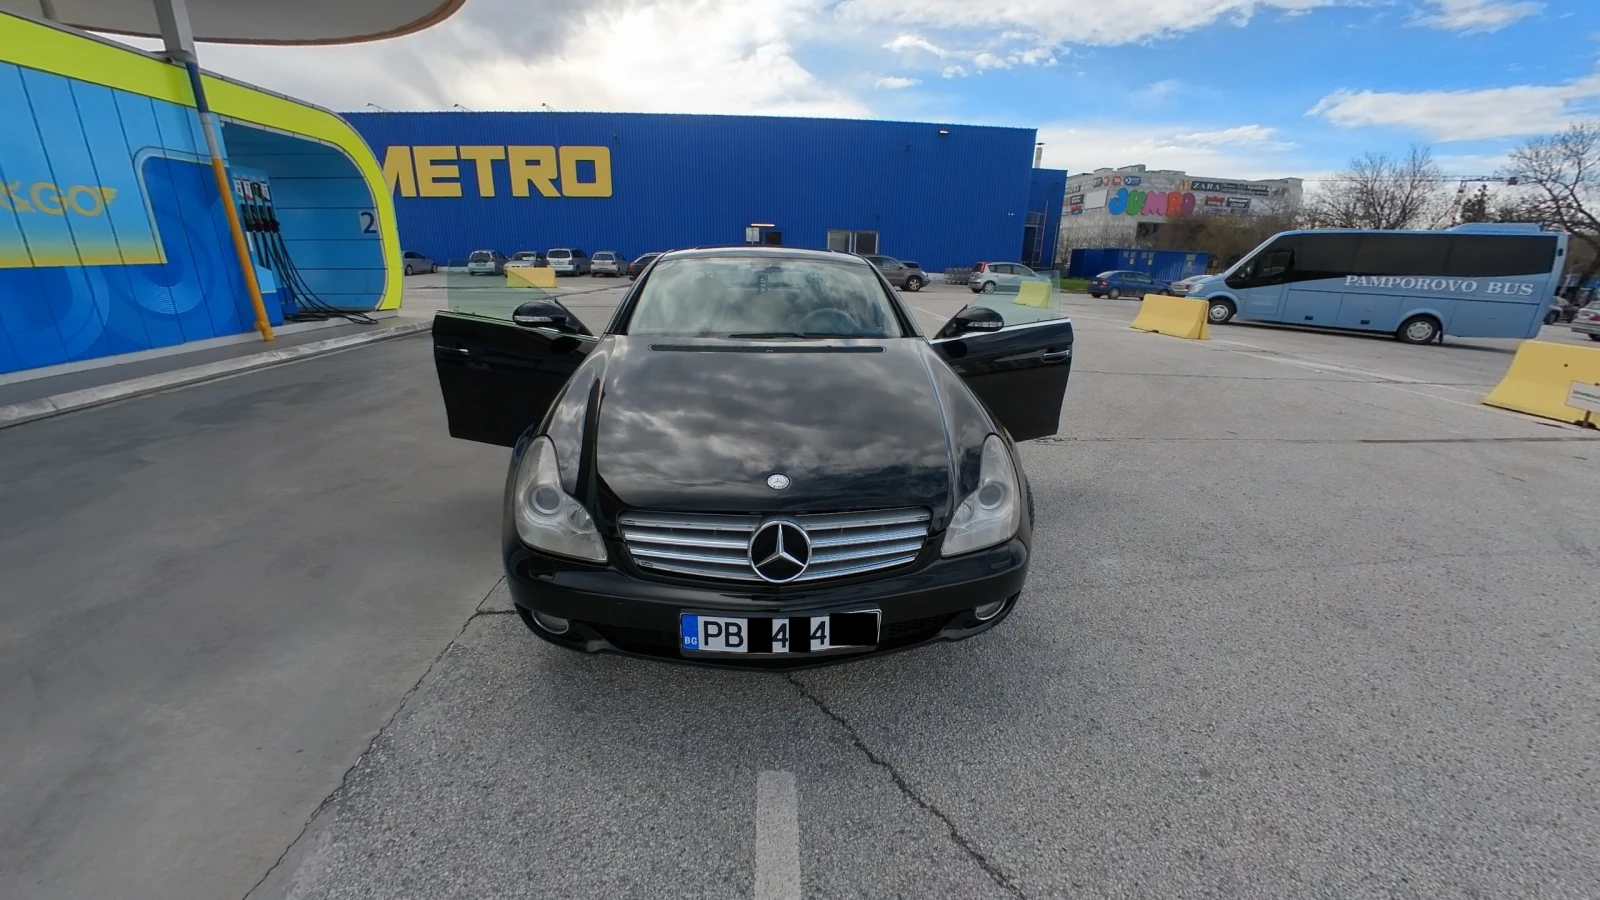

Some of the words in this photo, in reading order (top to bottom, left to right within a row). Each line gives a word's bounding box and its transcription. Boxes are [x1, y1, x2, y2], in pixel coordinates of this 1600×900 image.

[383, 145, 613, 197] METRO
[1193, 182, 1220, 191] ZARA
[1109, 187, 1196, 216] JUMBO
[360, 211, 378, 234] 2
[1344, 275, 1478, 292] PAMPOROVO
[1486, 281, 1534, 296] BUS
[684, 636, 698, 645] BG
[703, 620, 744, 648] PB
